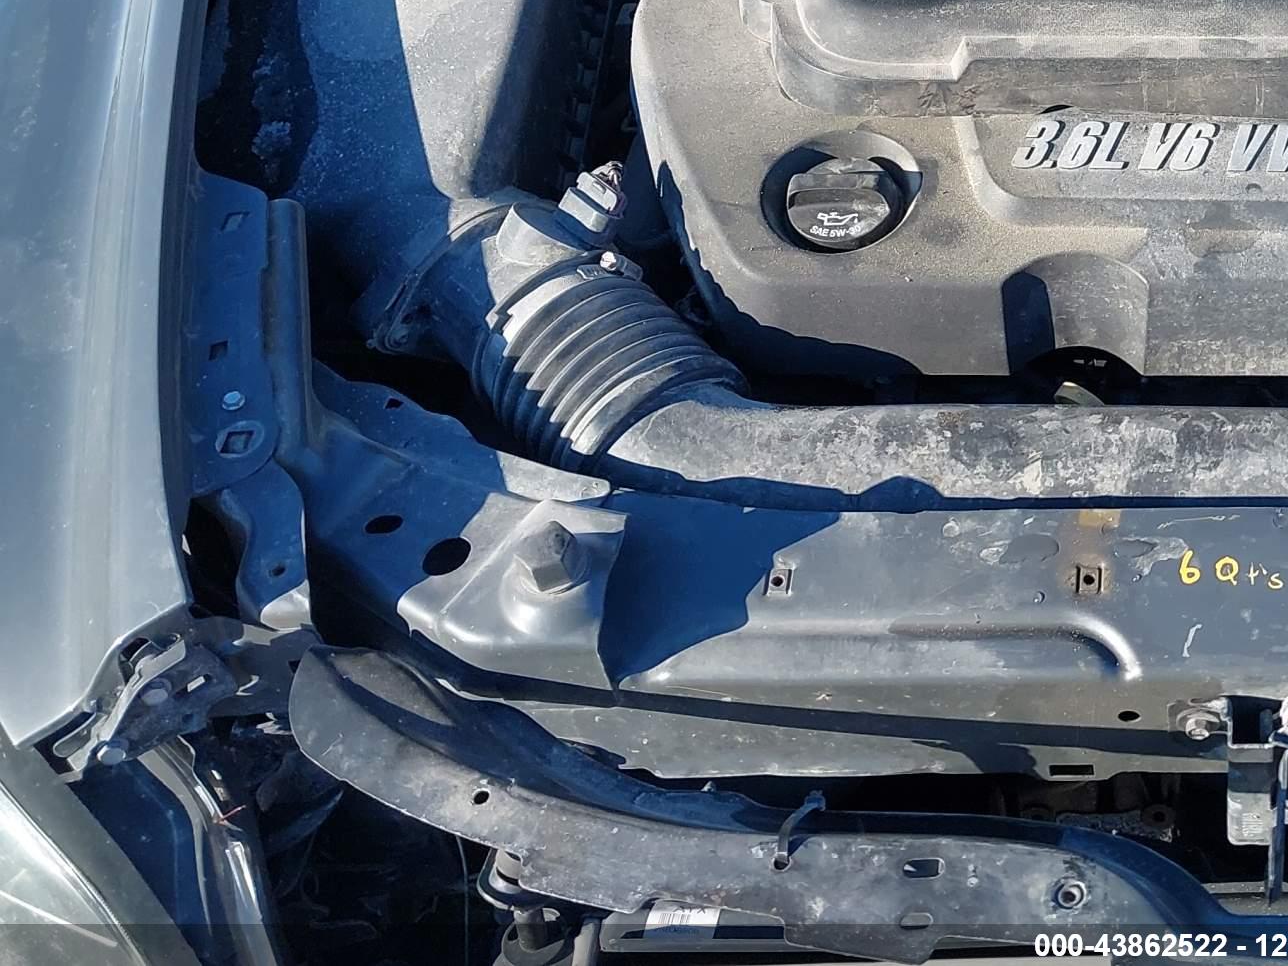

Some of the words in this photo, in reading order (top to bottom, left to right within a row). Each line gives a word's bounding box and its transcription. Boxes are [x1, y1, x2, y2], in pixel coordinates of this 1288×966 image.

[1011, 120, 1130, 171] 3.6L
[1138, 122, 1221, 172] V6
[811, 225, 829, 237] SAE
[830, 225, 862, 237] 5W-30
[1179, 550, 1201, 585] 6
